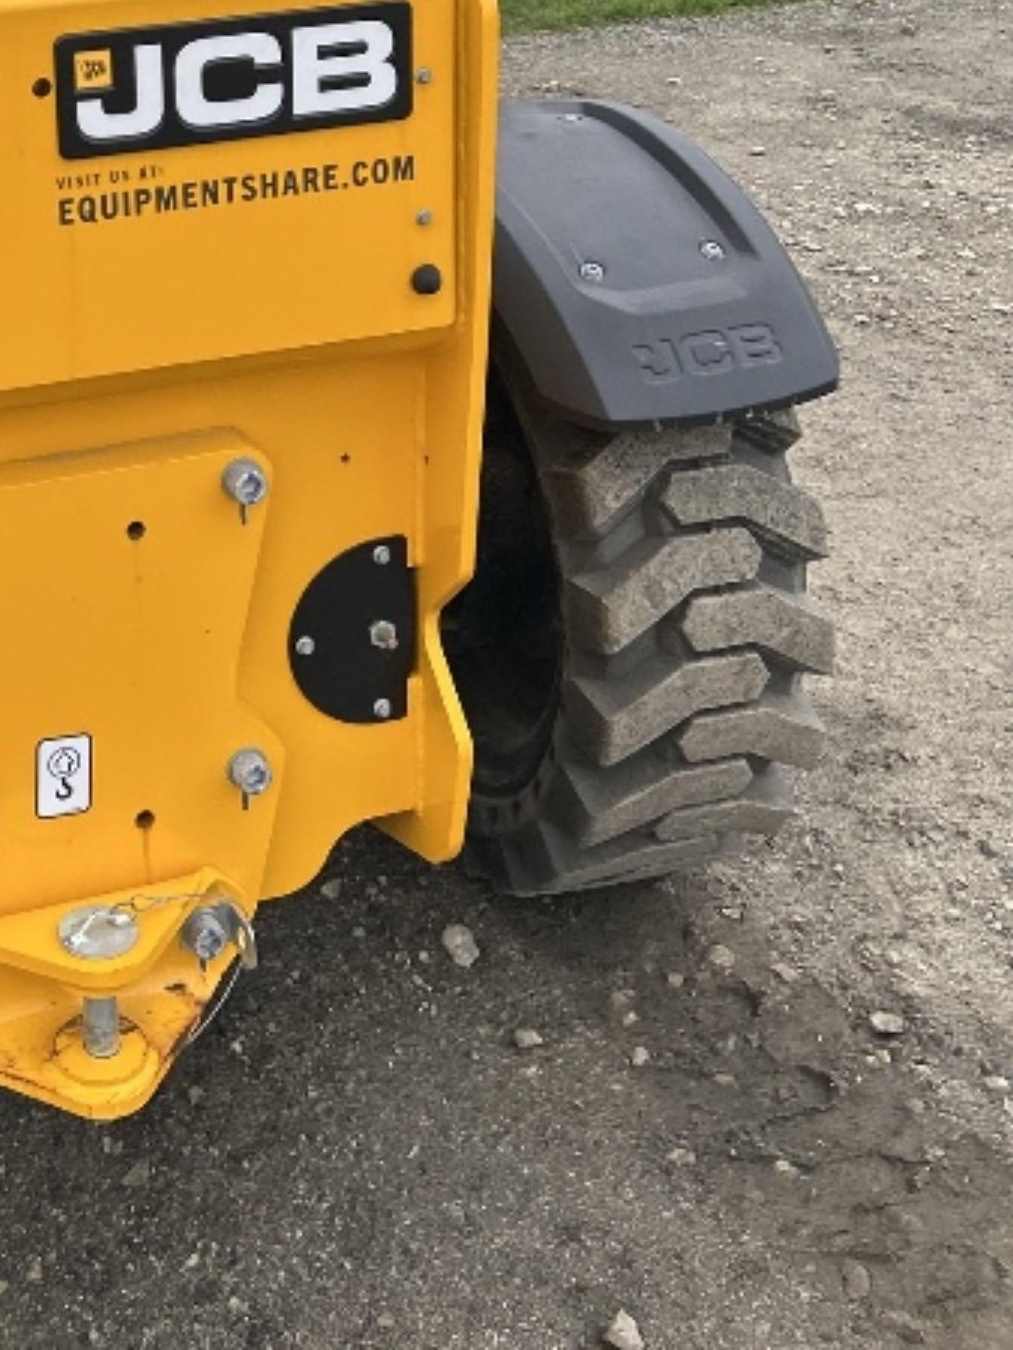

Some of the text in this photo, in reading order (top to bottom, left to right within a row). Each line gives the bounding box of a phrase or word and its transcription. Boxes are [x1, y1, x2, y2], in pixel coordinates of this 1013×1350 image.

[75, 19, 399, 140] JCB
[56, 173, 100, 190] VISIT
[109, 169, 129, 184] US
[58, 155, 415, 226] EQUIPMENTSHARE.COM
[632, 321, 783, 385] JCB
